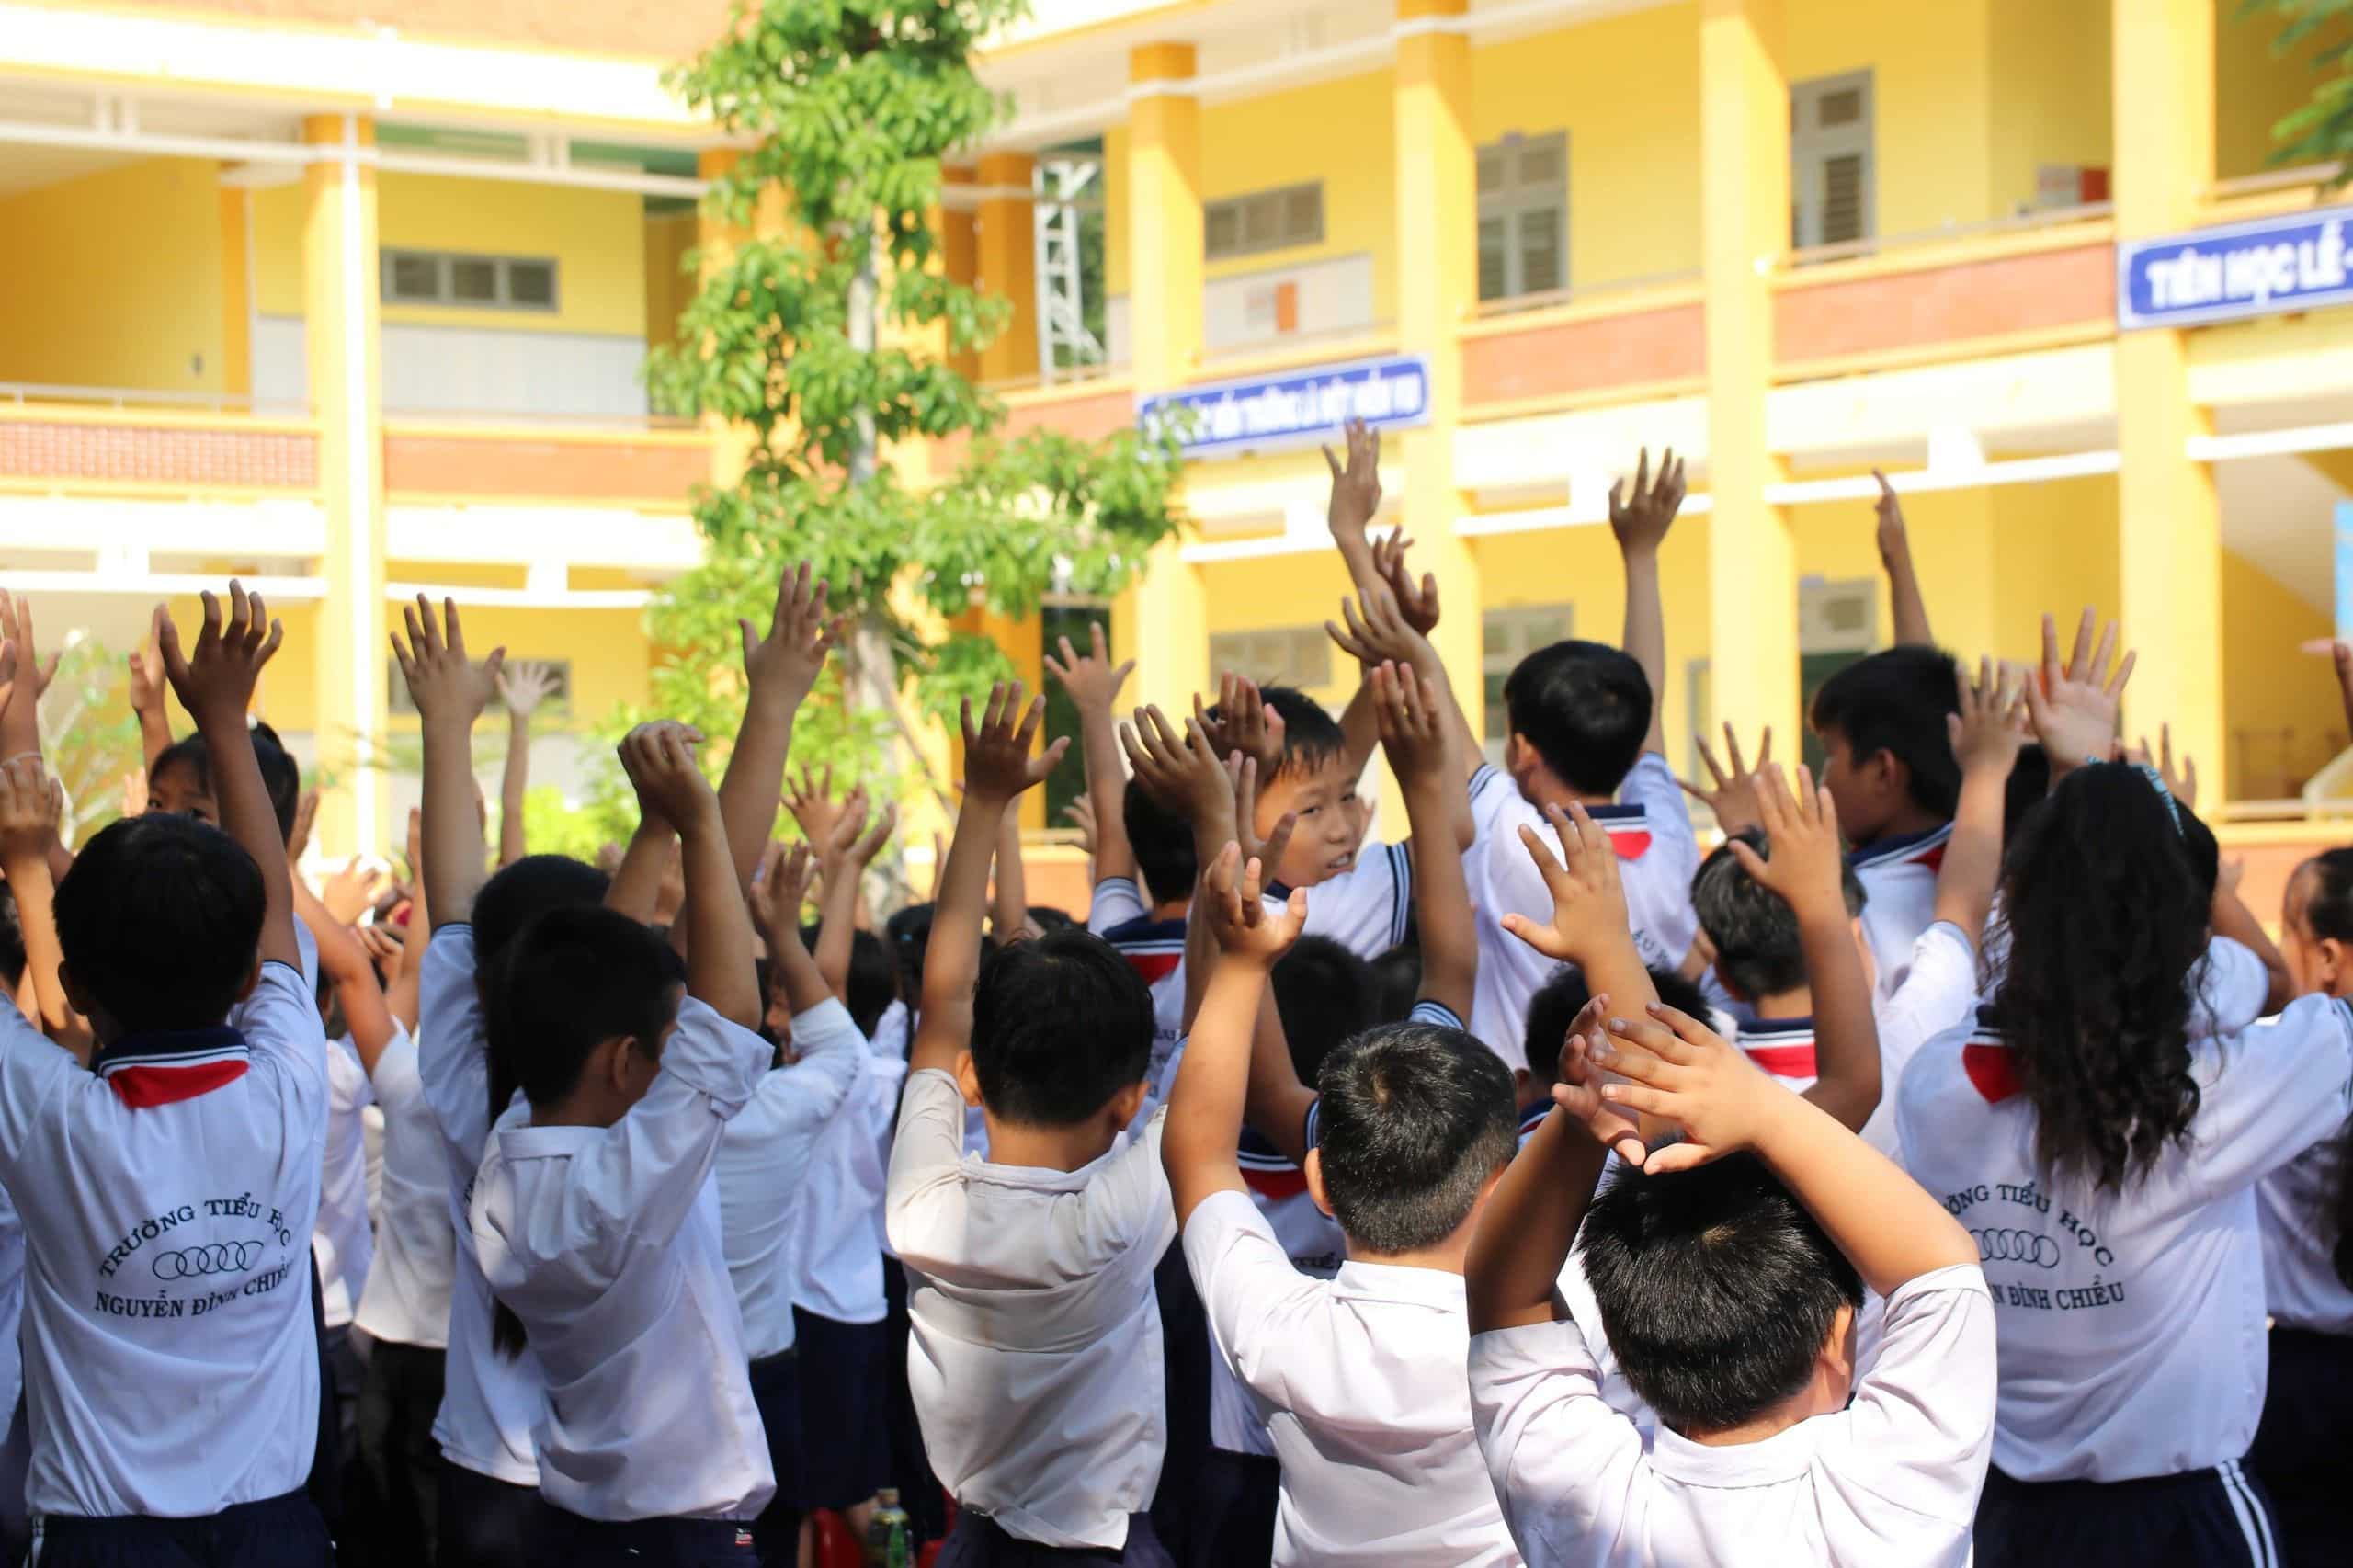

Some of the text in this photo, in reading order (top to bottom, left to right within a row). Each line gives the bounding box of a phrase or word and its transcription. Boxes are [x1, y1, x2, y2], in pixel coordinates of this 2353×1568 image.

[98, 1205, 195, 1278] TRƯỜNG
[204, 1192, 261, 1219] TIỂU
[1996, 1181, 2052, 1213] TIỂU
[2059, 1210, 2114, 1267] HỌC
[96, 1290, 186, 1317] NGUYỄN
[2009, 1281, 2052, 1309] ĐÌNH
